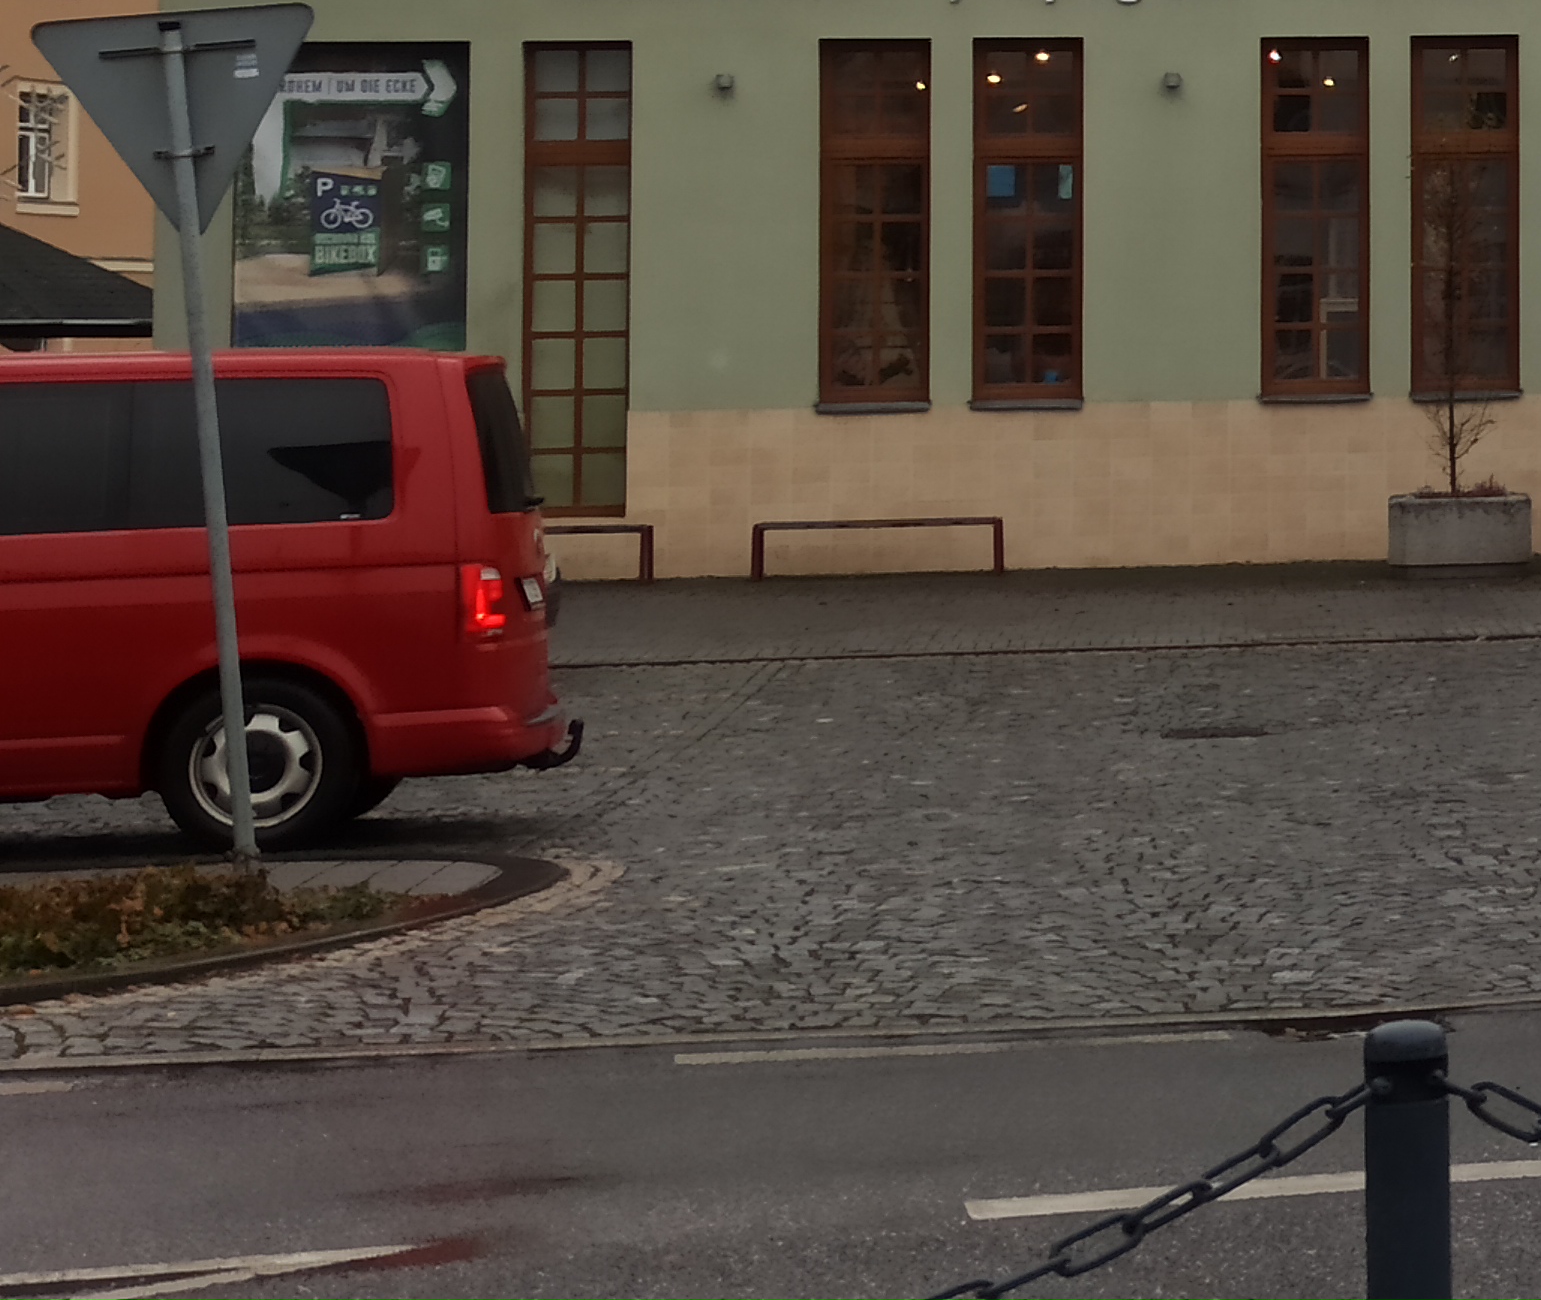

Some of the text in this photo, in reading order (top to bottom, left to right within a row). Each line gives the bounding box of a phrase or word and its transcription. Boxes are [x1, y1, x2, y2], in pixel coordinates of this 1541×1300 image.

[385, 79, 417, 93] ECKE
[316, 177, 334, 197] P
[314, 245, 376, 264] BIKEBOX
